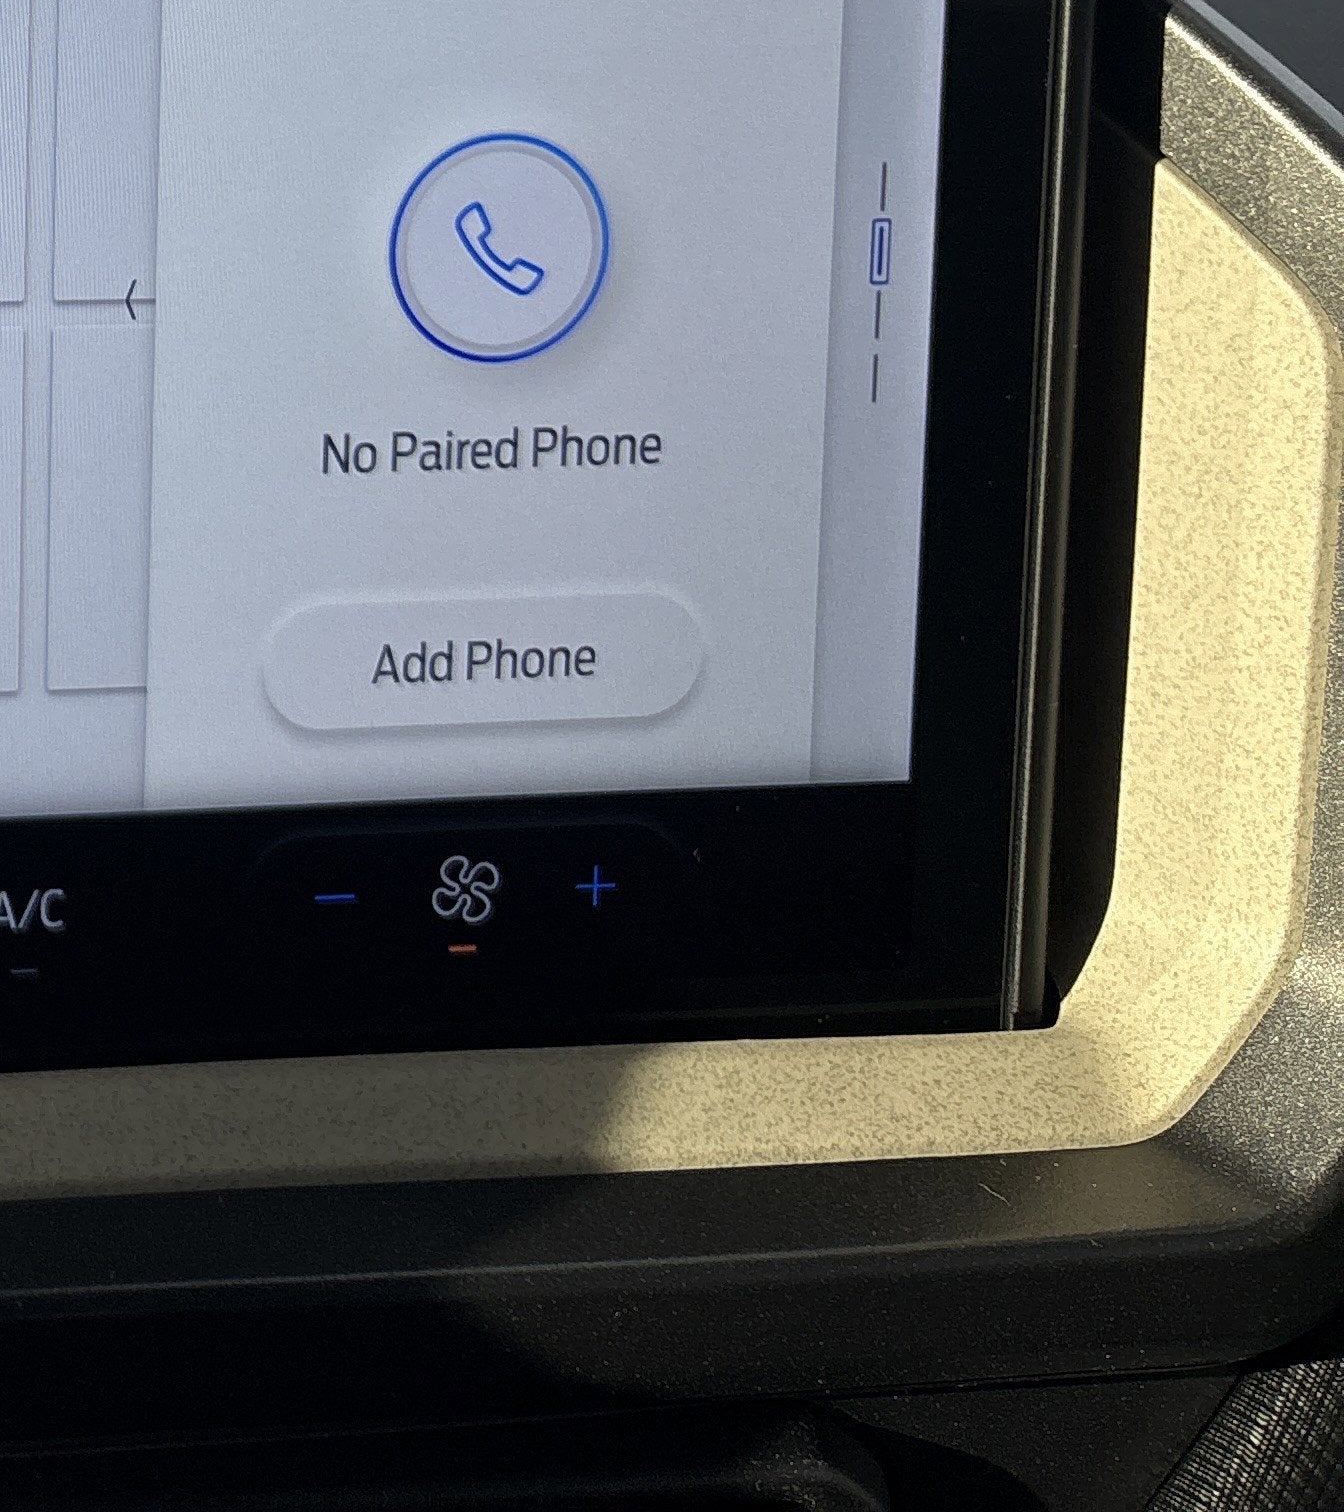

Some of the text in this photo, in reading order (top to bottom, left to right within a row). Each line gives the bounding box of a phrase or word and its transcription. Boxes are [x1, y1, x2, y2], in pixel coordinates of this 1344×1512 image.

[322, 425, 663, 475] No Paired Phone
[372, 638, 597, 684] Add Phone
